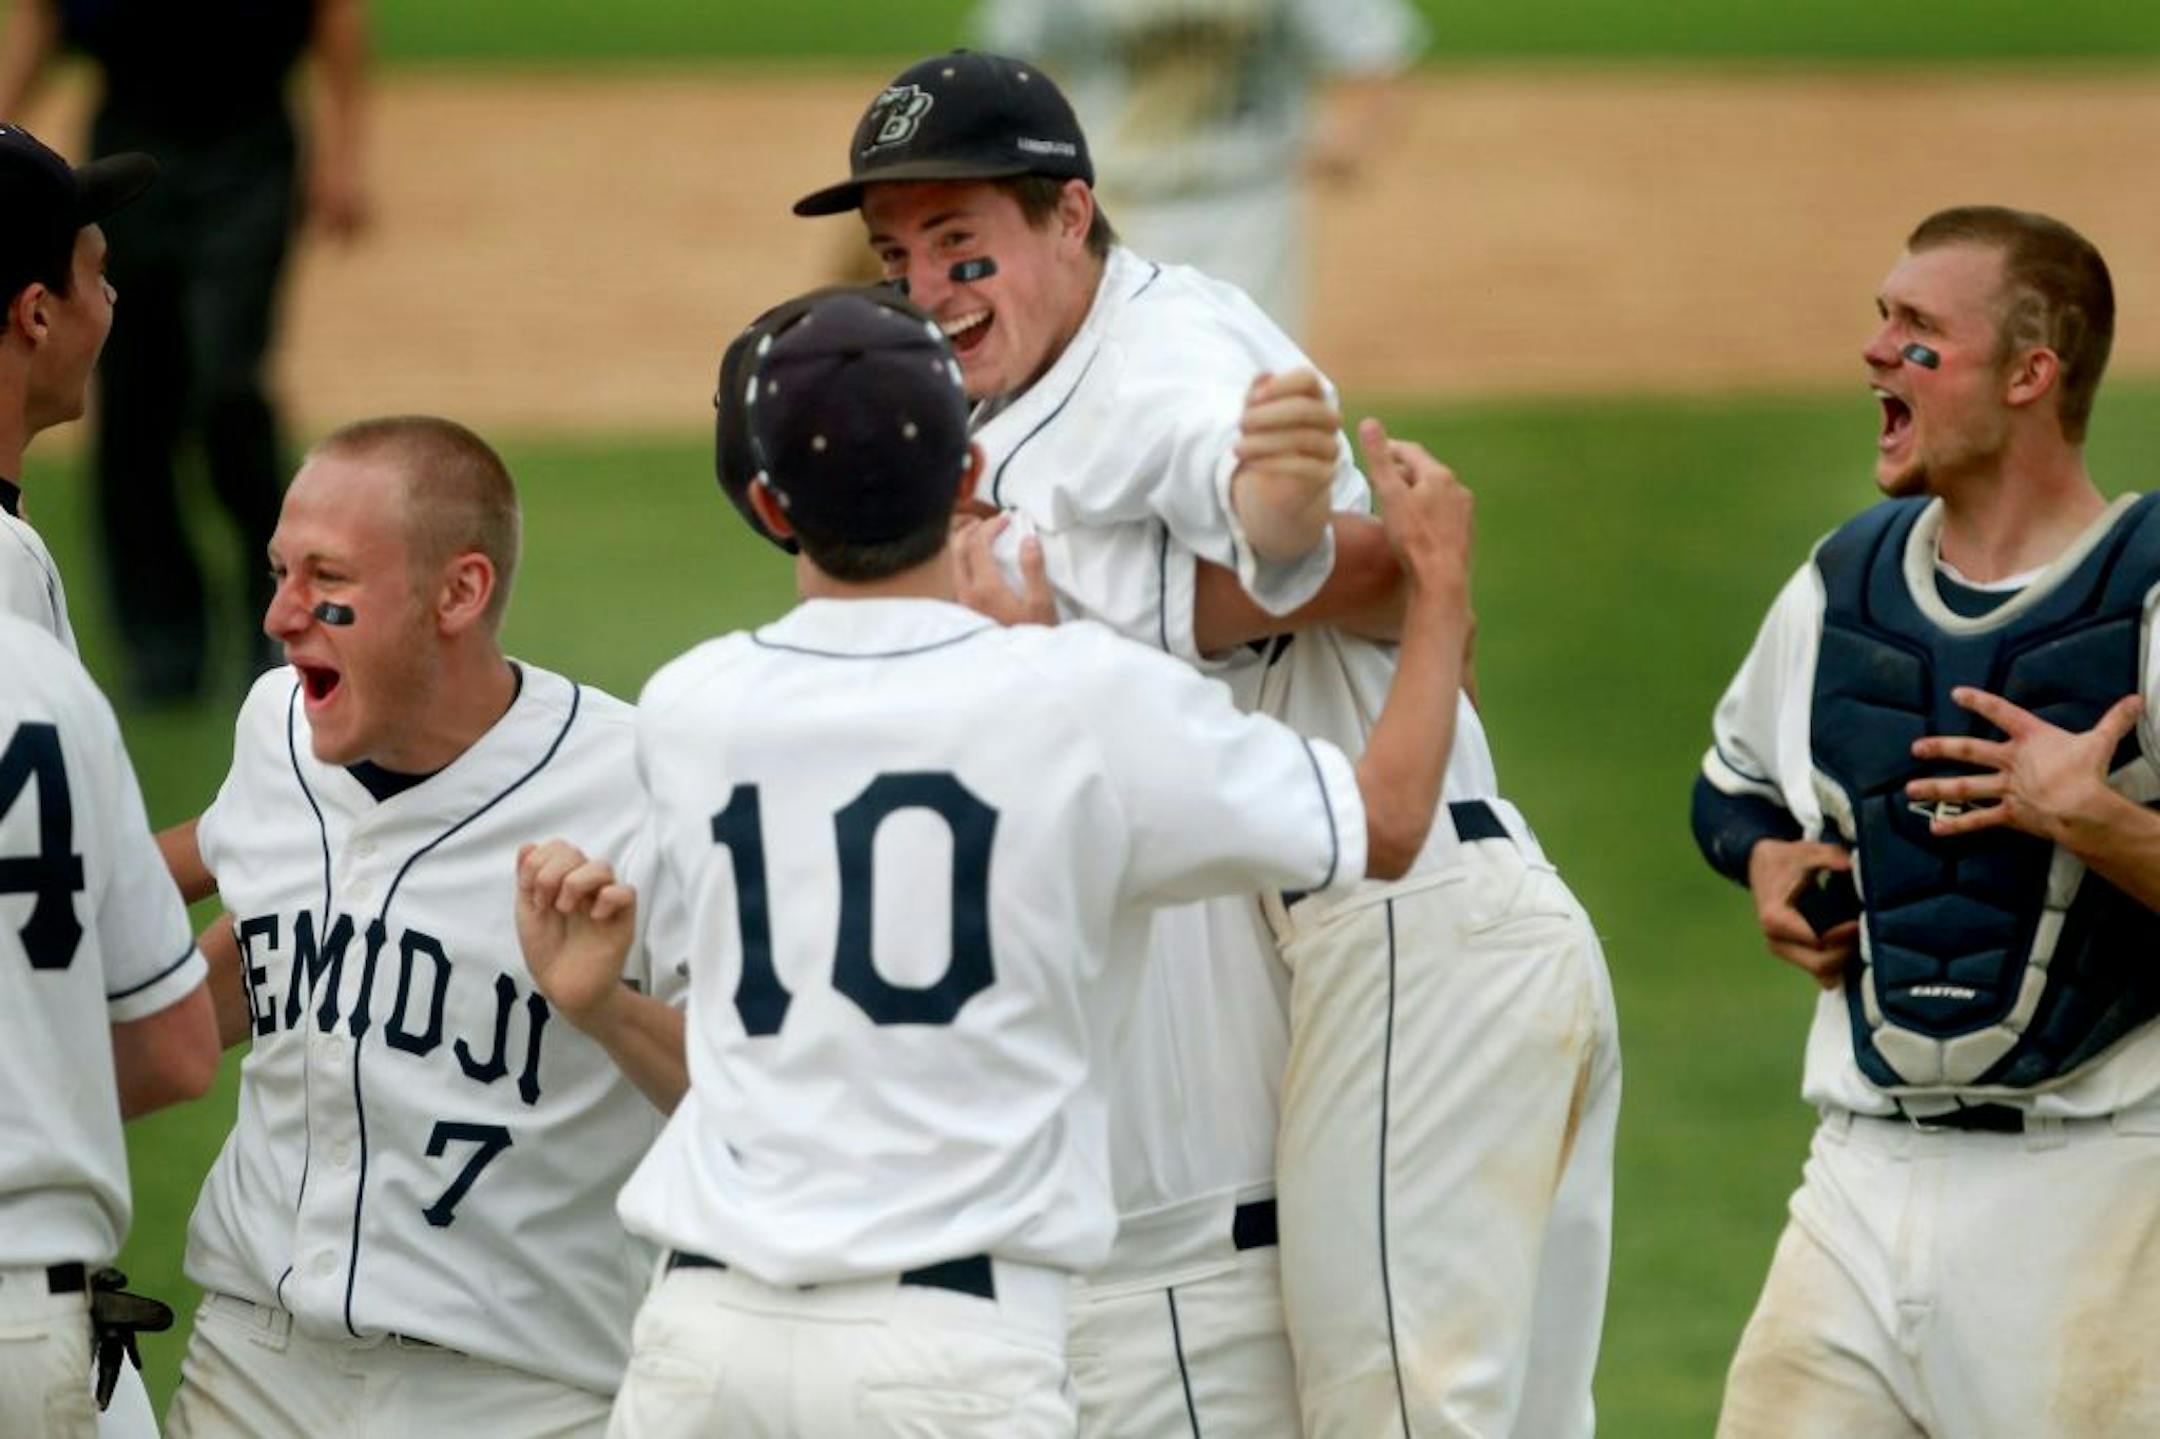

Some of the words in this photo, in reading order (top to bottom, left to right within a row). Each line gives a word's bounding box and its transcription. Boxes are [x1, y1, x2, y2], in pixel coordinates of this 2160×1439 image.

[0, 722, 84, 970] 4
[710, 771, 1000, 1037] 10
[238, 910, 550, 1105] EMIDJI
[1909, 985, 1976, 1000] EASTON
[422, 1121, 513, 1227] 7
